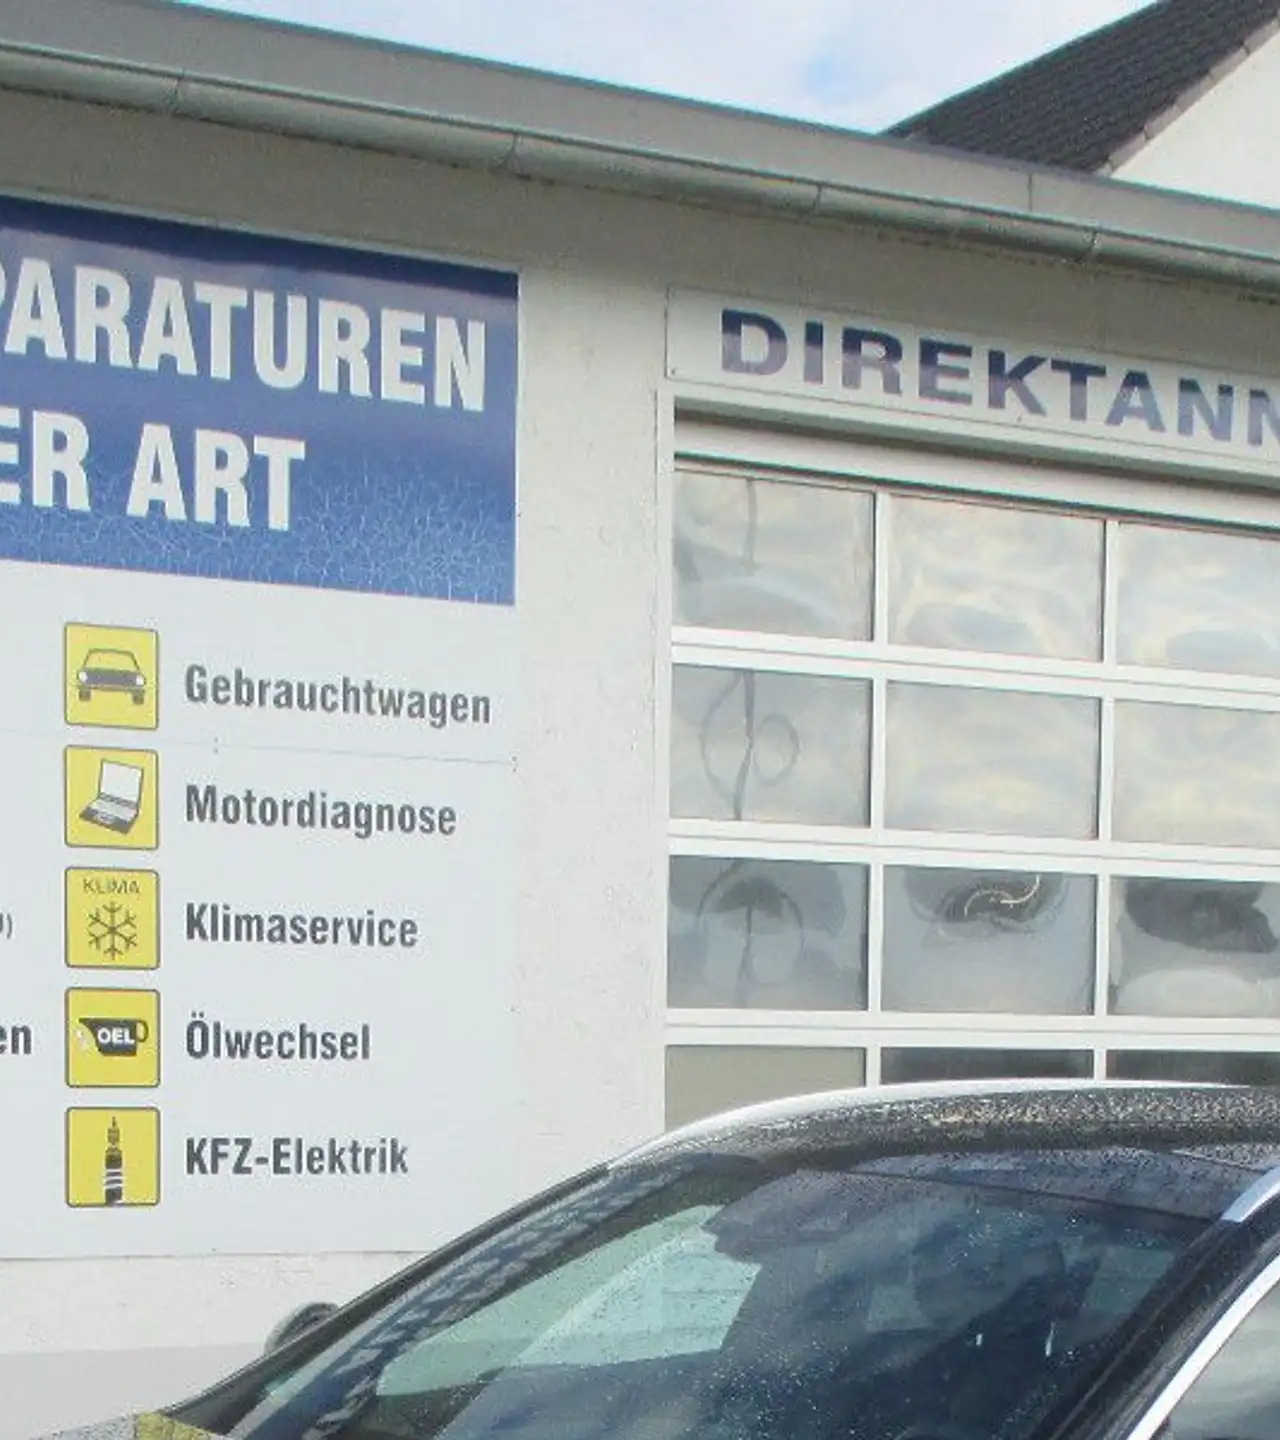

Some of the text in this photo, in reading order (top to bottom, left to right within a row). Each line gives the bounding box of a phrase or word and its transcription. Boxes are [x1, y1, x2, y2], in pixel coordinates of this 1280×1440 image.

[125, 422, 306, 531] ART
[184, 664, 492, 729] Gebrauchtwagen
[185, 784, 458, 838] Motordiagnose
[83, 877, 141, 897] KLIMA
[185, 902, 419, 949] Klimaservice
[96, 1026, 135, 1045] OEL
[185, 1010, 371, 1060] Ölwechsel
[185, 1137, 408, 1176] KFZ-Elektrik
